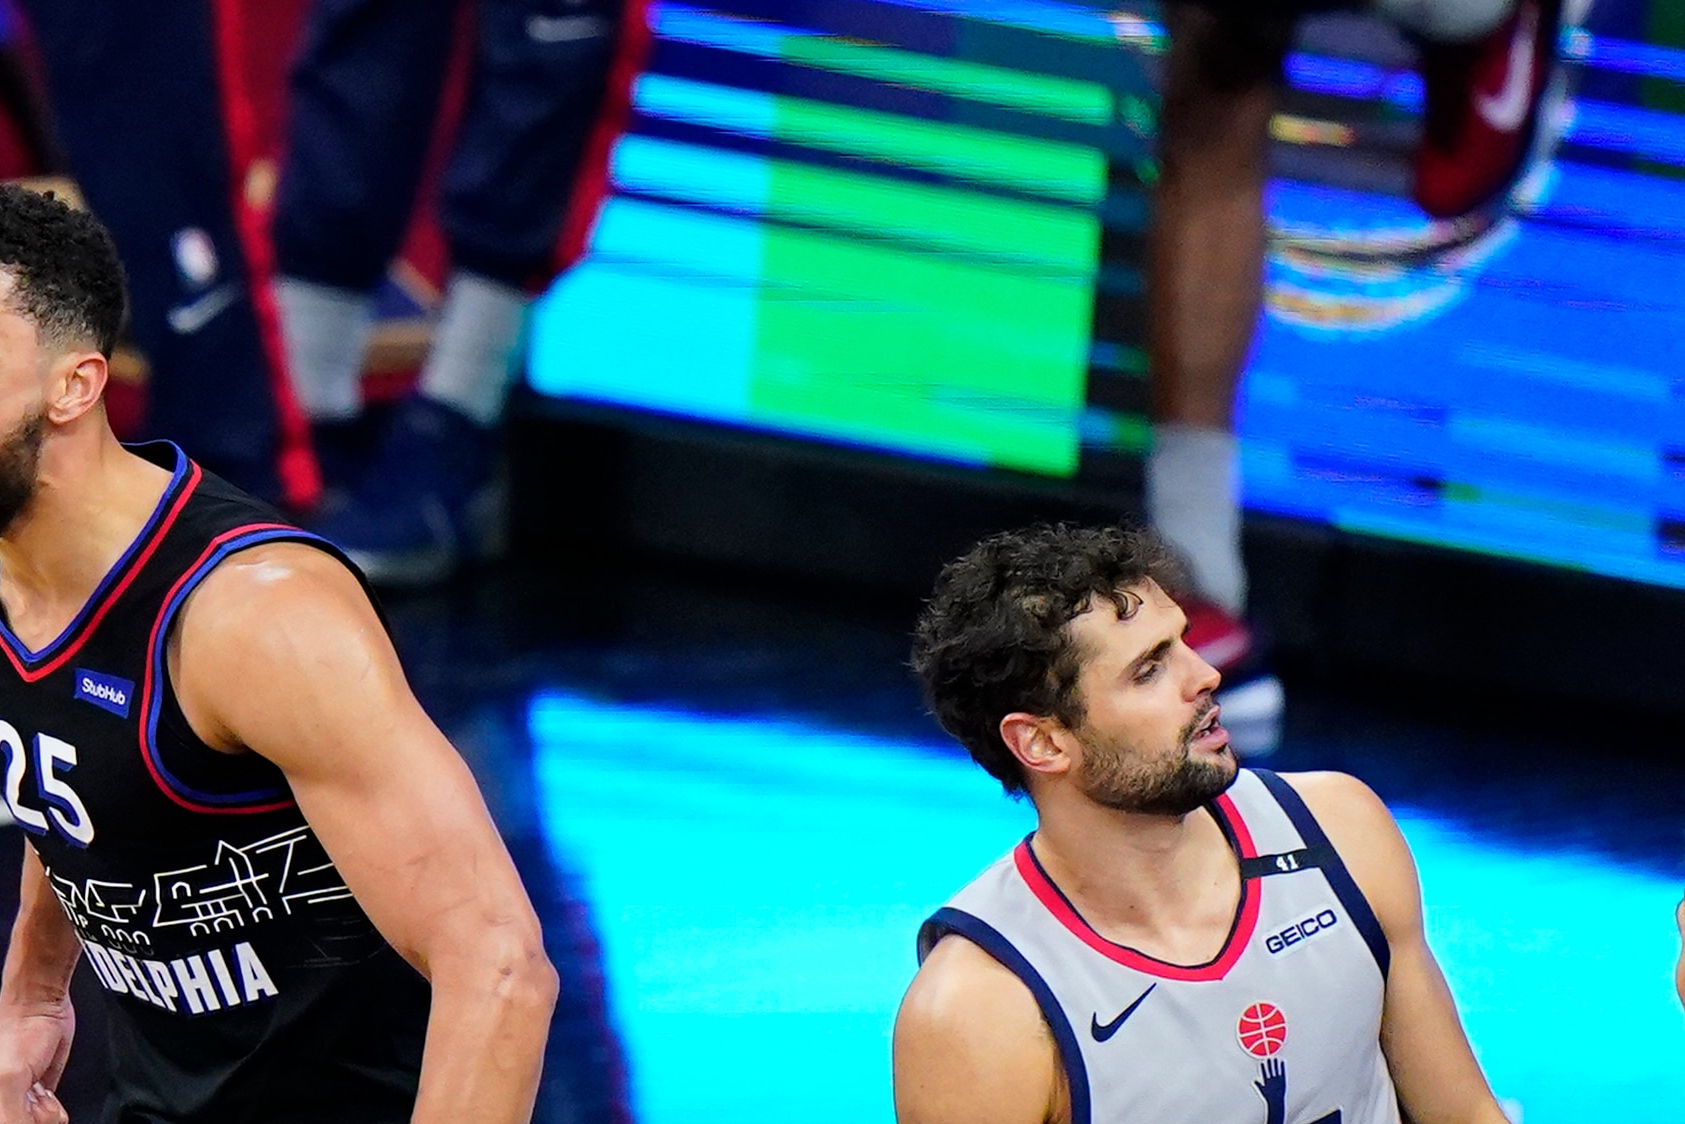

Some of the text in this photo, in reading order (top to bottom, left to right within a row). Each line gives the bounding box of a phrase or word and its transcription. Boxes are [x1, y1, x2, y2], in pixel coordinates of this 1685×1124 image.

[82, 677, 126, 705] StubHub
[1275, 853, 1298, 871] 41
[1265, 908, 1337, 954] GEICO
[81, 939, 279, 1015] DELPHIA
